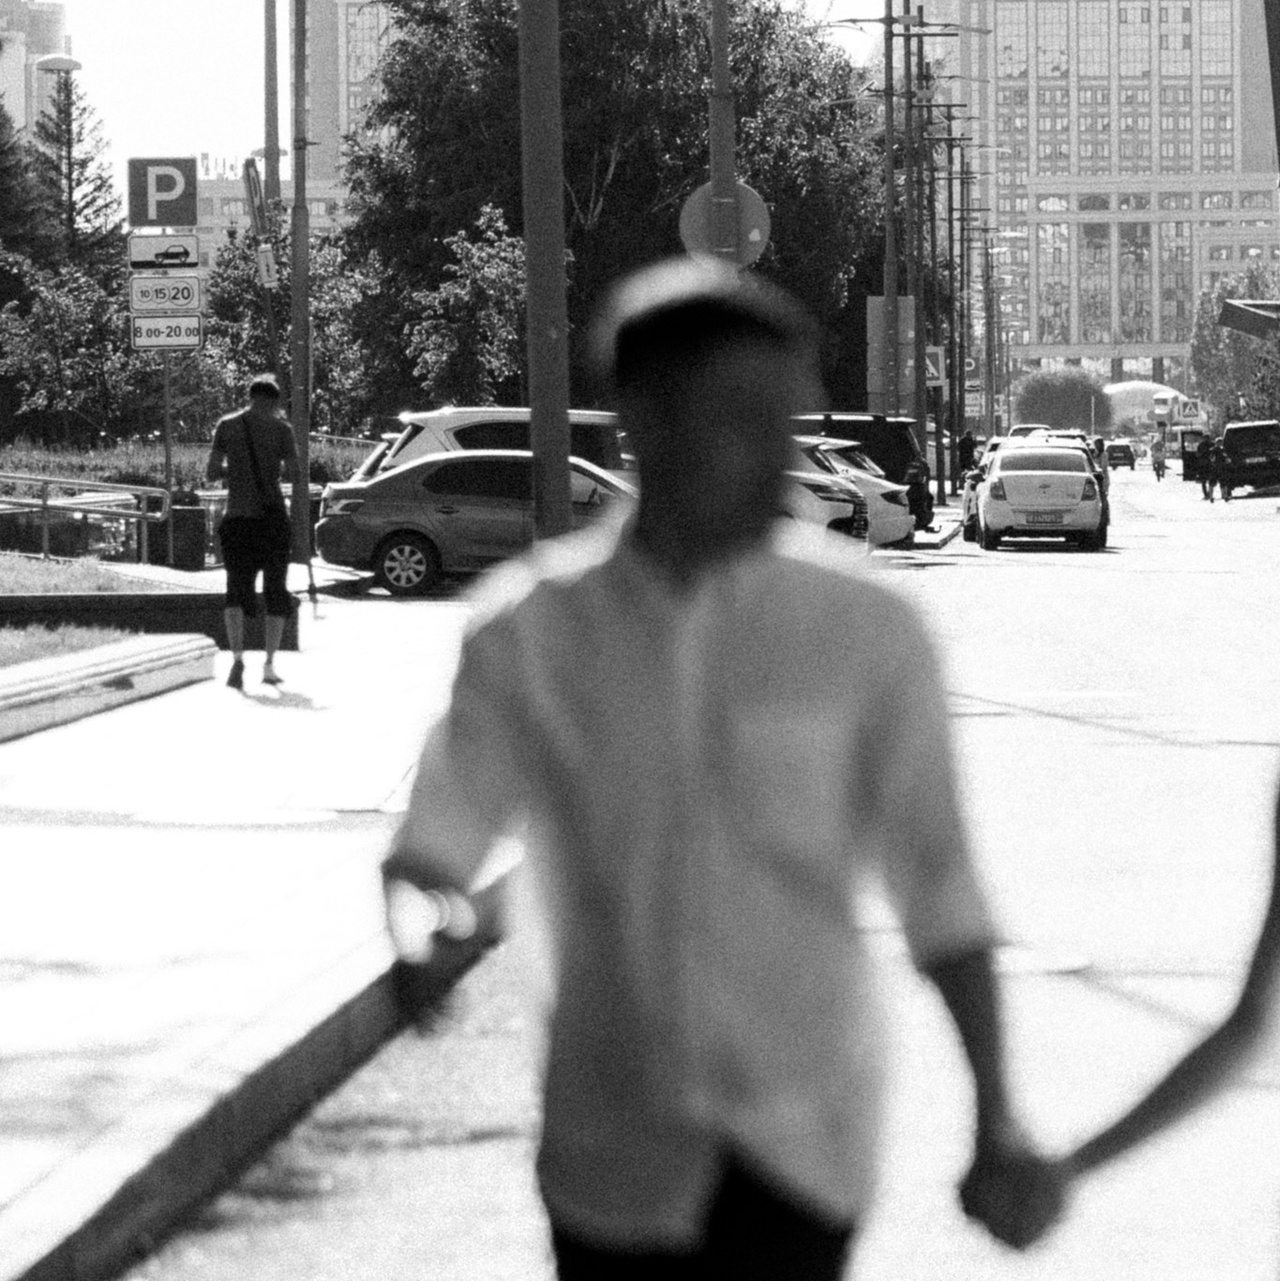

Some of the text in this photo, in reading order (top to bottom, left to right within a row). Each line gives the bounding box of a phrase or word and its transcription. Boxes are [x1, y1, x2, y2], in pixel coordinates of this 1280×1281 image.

[147, 166, 185, 219] P
[140, 287, 190, 300] 10 15 20
